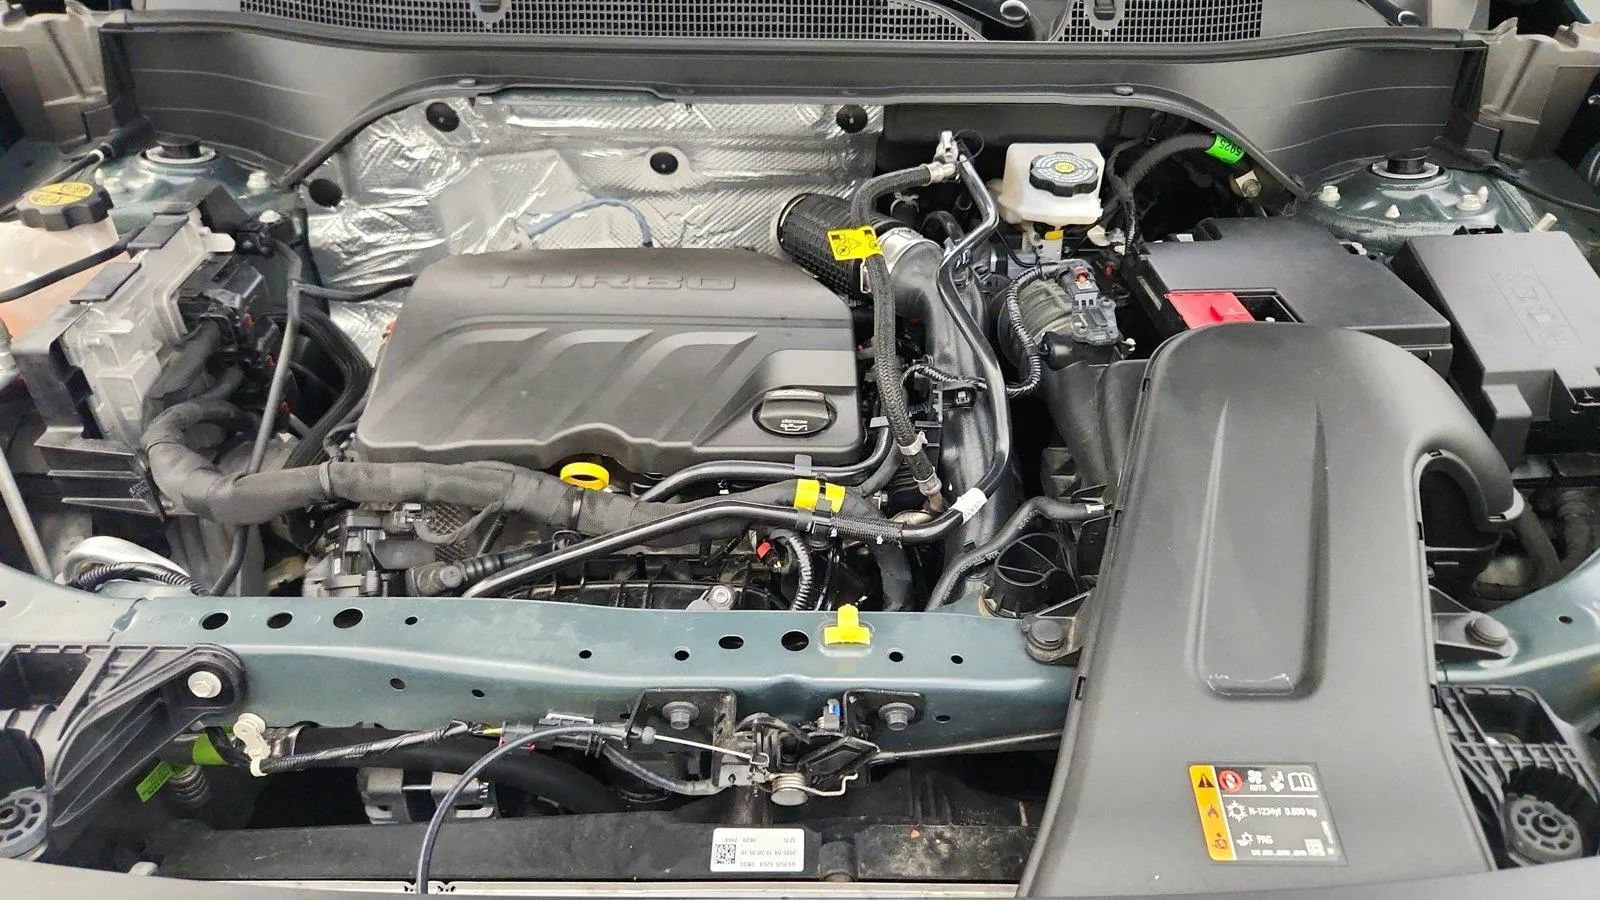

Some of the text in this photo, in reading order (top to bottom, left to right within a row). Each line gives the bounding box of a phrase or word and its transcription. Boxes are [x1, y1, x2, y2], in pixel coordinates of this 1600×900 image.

[1219, 138, 1243, 156] 5925
[477, 272, 736, 291] TURBO
[1306, 807, 1317, 817] kg
